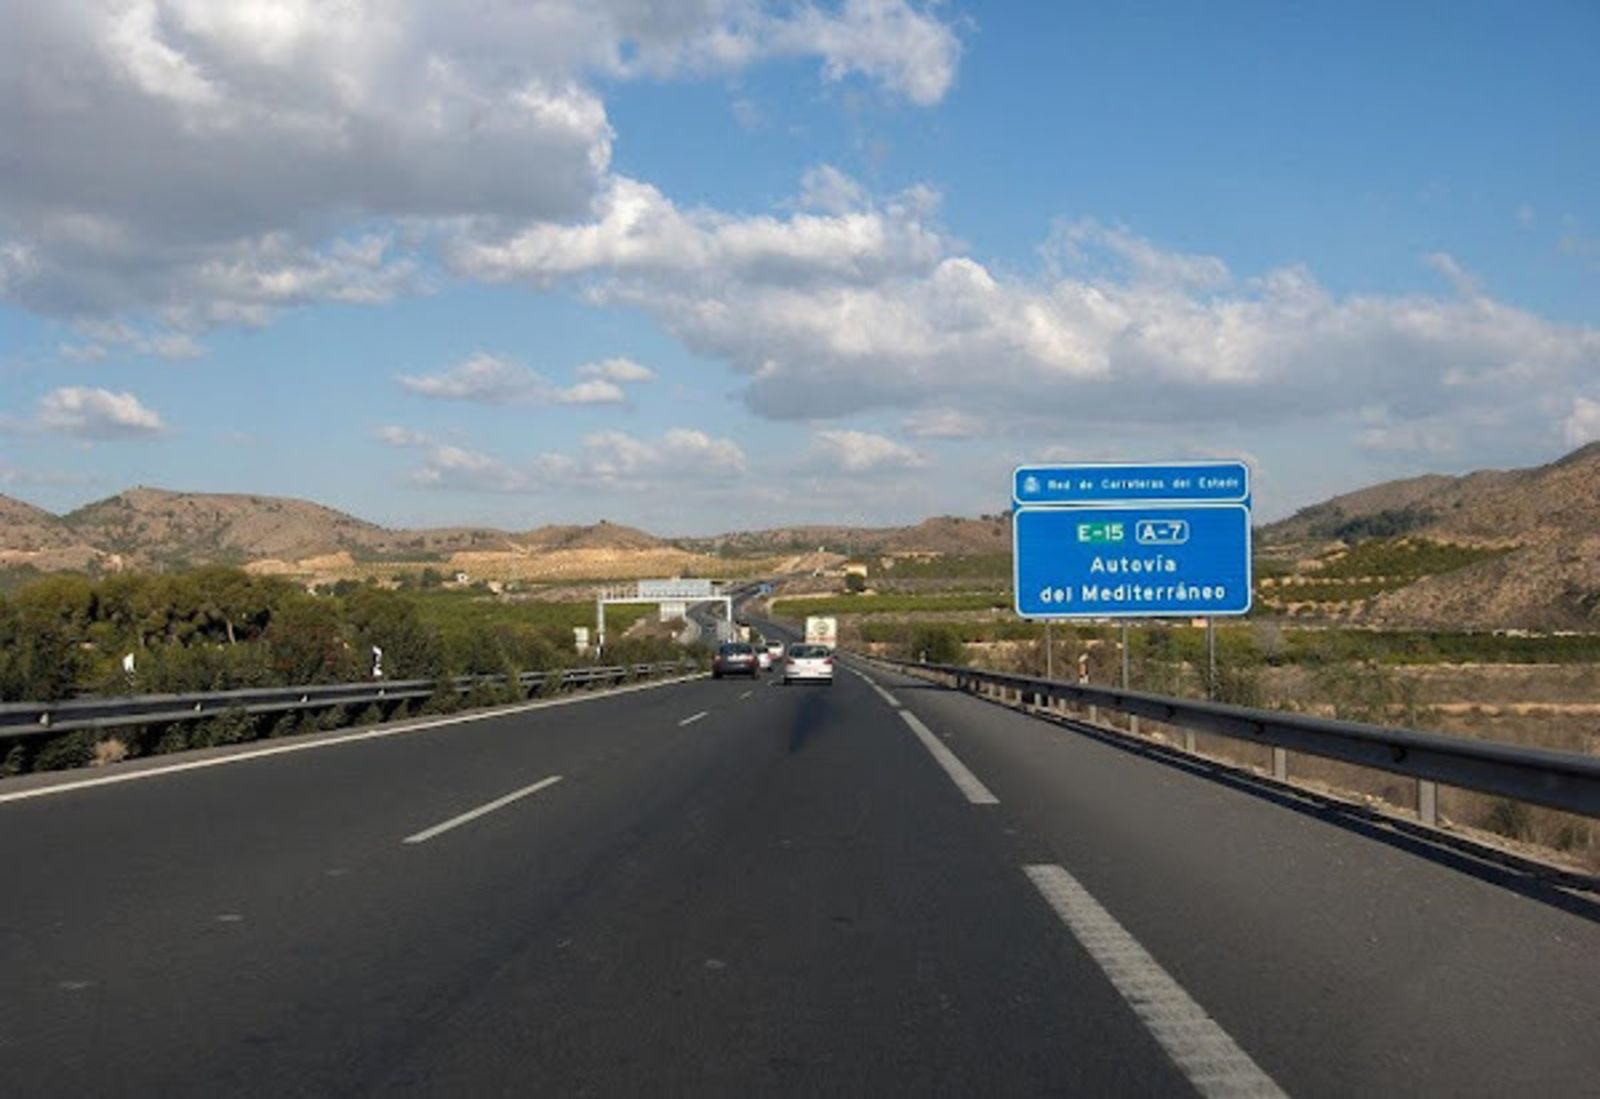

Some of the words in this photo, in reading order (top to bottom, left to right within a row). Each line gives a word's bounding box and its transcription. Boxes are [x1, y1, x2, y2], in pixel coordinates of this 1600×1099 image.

[1078, 523, 1124, 541] E-15
[1142, 523, 1182, 540] A-7
[1090, 554, 1177, 574] Autovía
[1040, 586, 1072, 603] del
[1082, 581, 1225, 602] Mediterráneo
